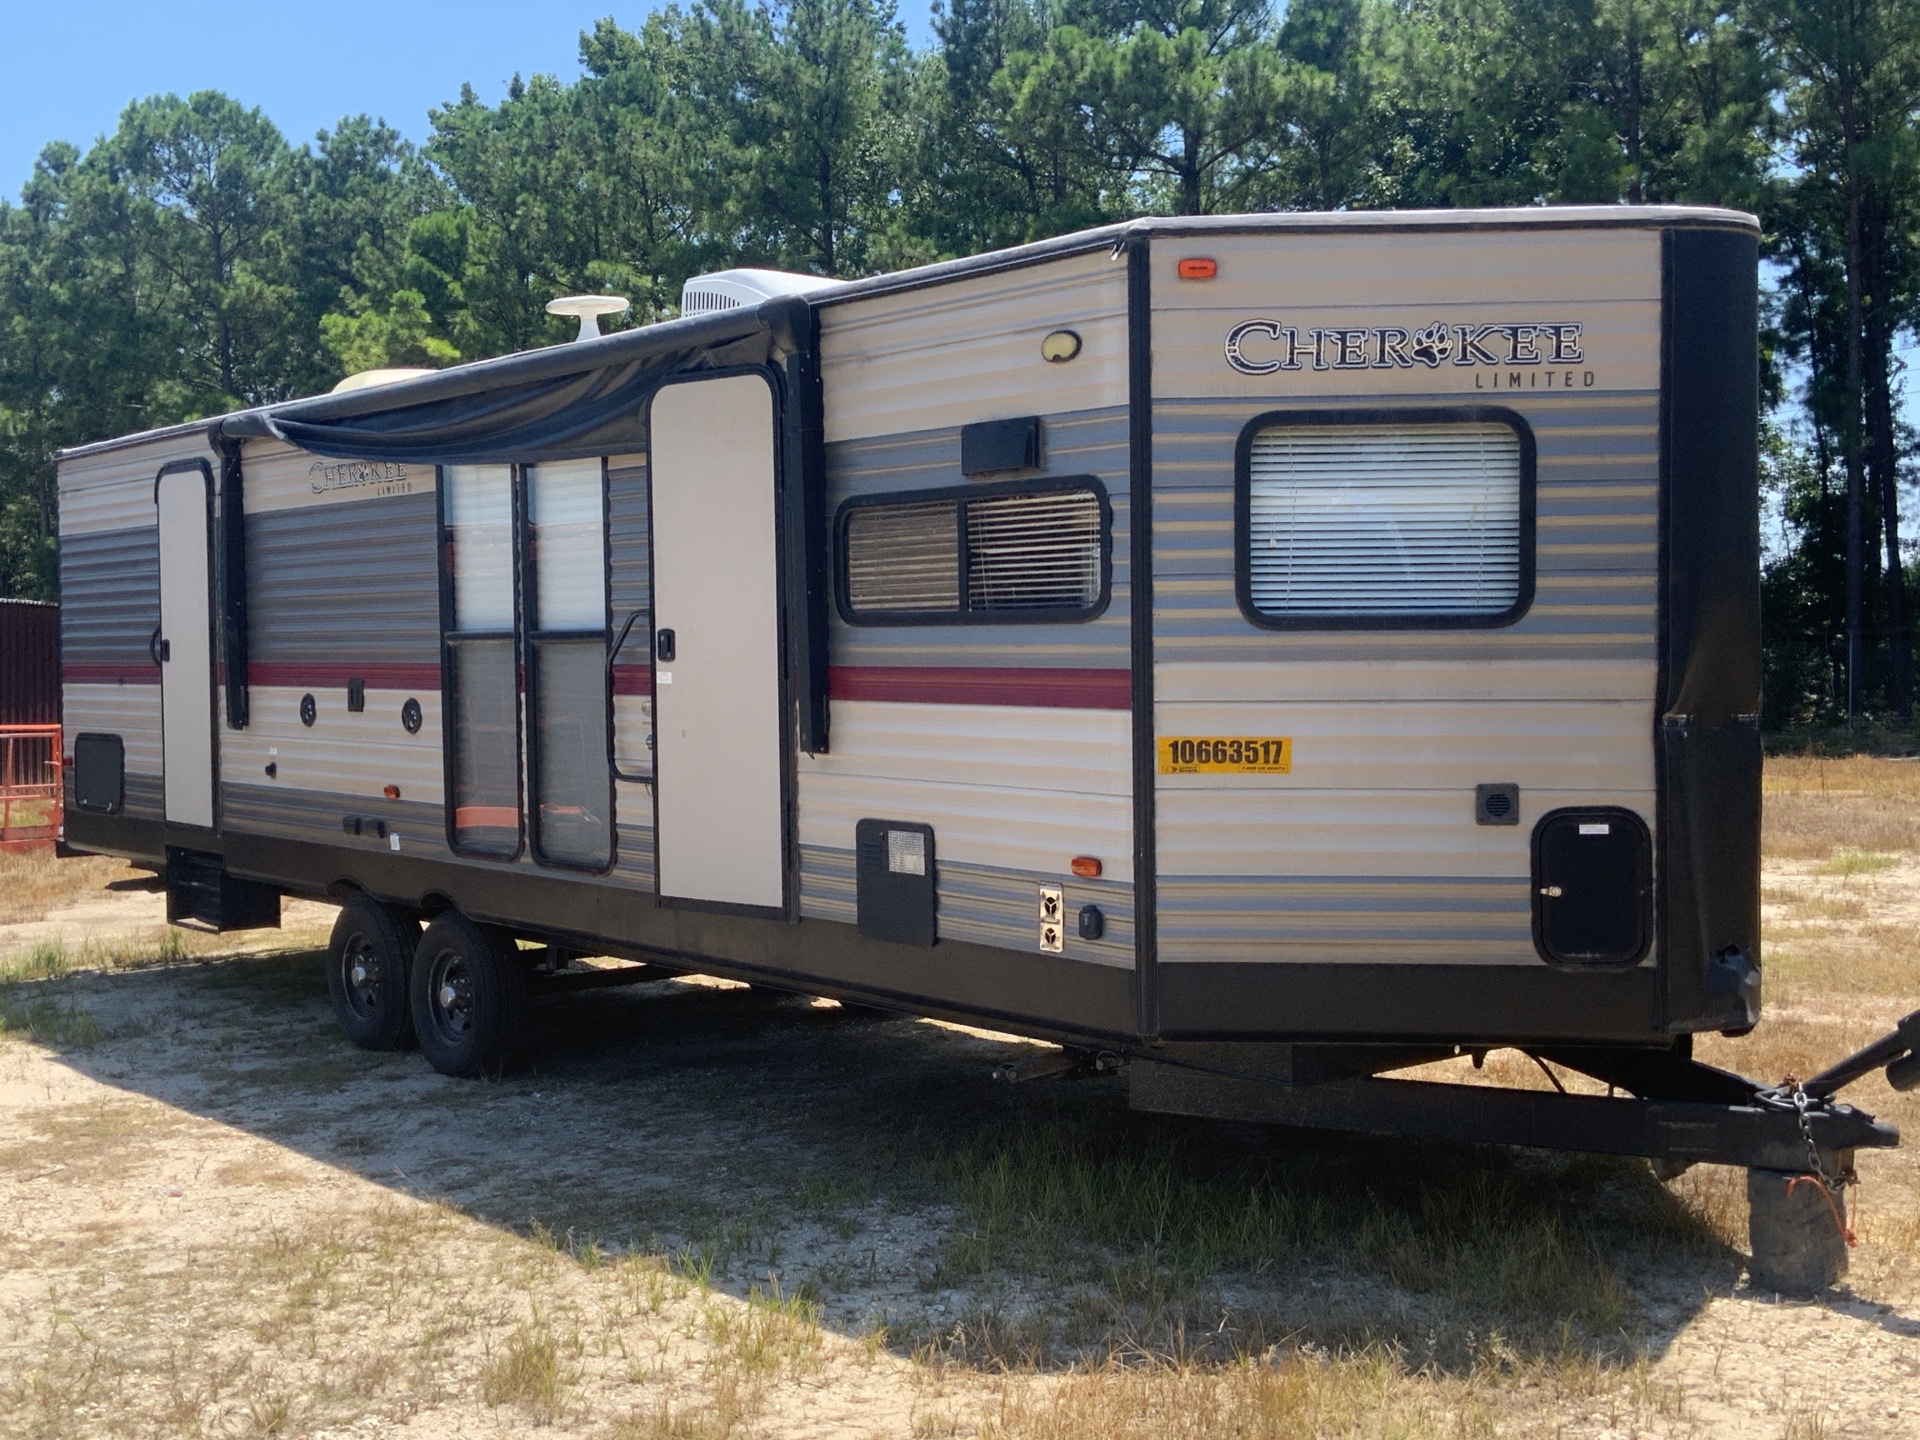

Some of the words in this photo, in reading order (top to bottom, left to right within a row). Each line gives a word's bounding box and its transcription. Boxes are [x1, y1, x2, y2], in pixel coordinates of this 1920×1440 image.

[1475, 371, 1596, 389] LIMITED
[377, 482, 412, 496] LIMITED
[1168, 739, 1283, 765] 10663517
